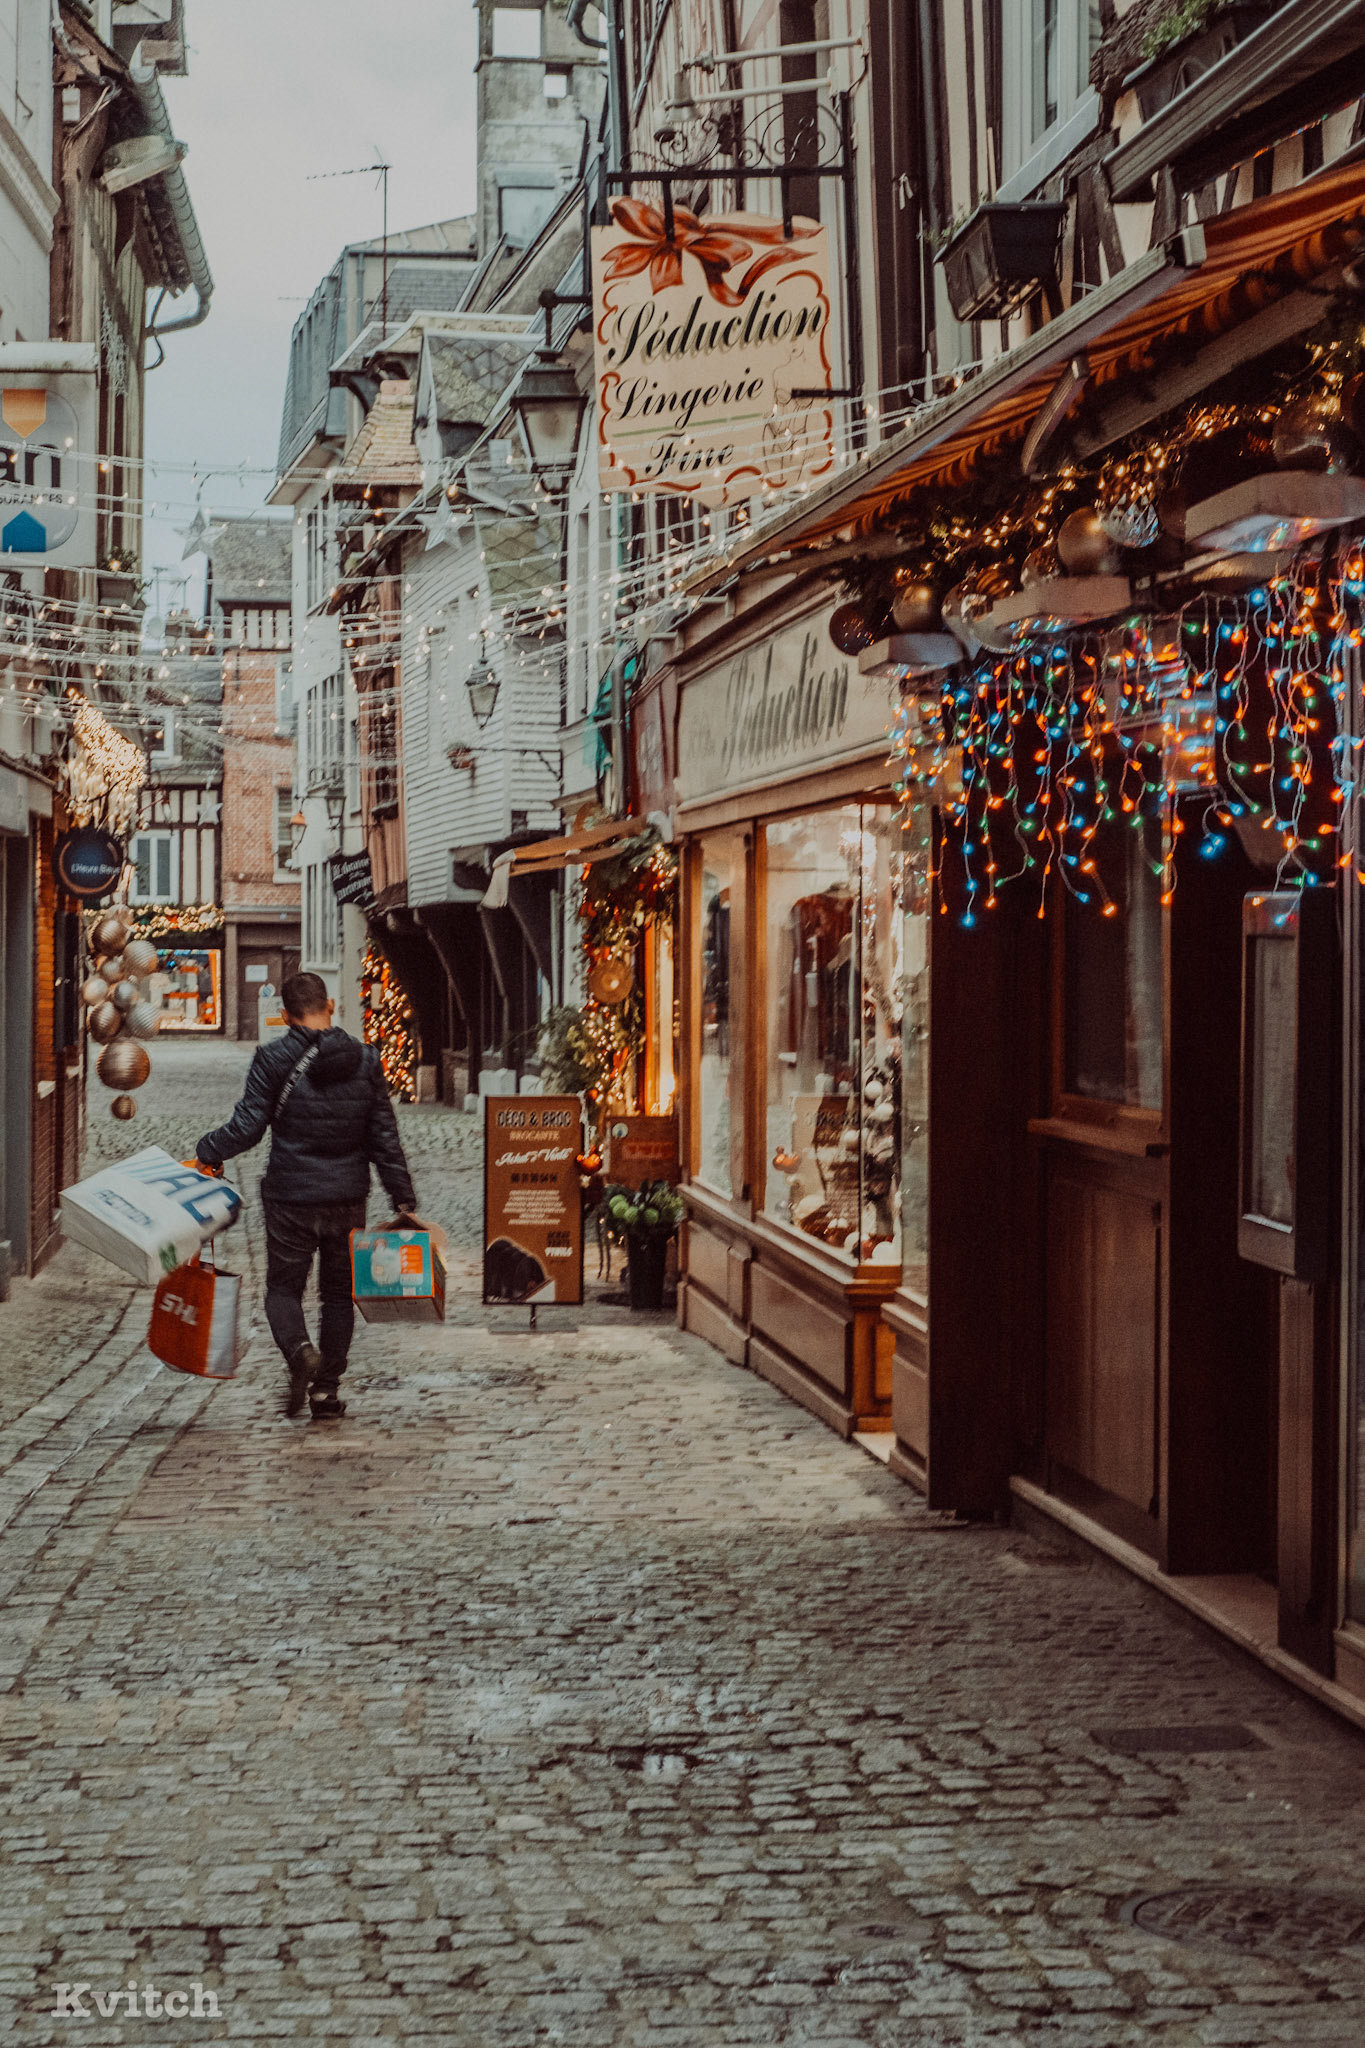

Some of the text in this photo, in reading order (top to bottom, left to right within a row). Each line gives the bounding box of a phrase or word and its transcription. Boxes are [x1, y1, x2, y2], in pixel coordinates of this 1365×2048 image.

[604, 290, 823, 366] Séduction
[611, 366, 765, 430] Lingerie
[645, 432, 735, 477] Fine
[496, 1106, 572, 1128] DÉCO & BROC
